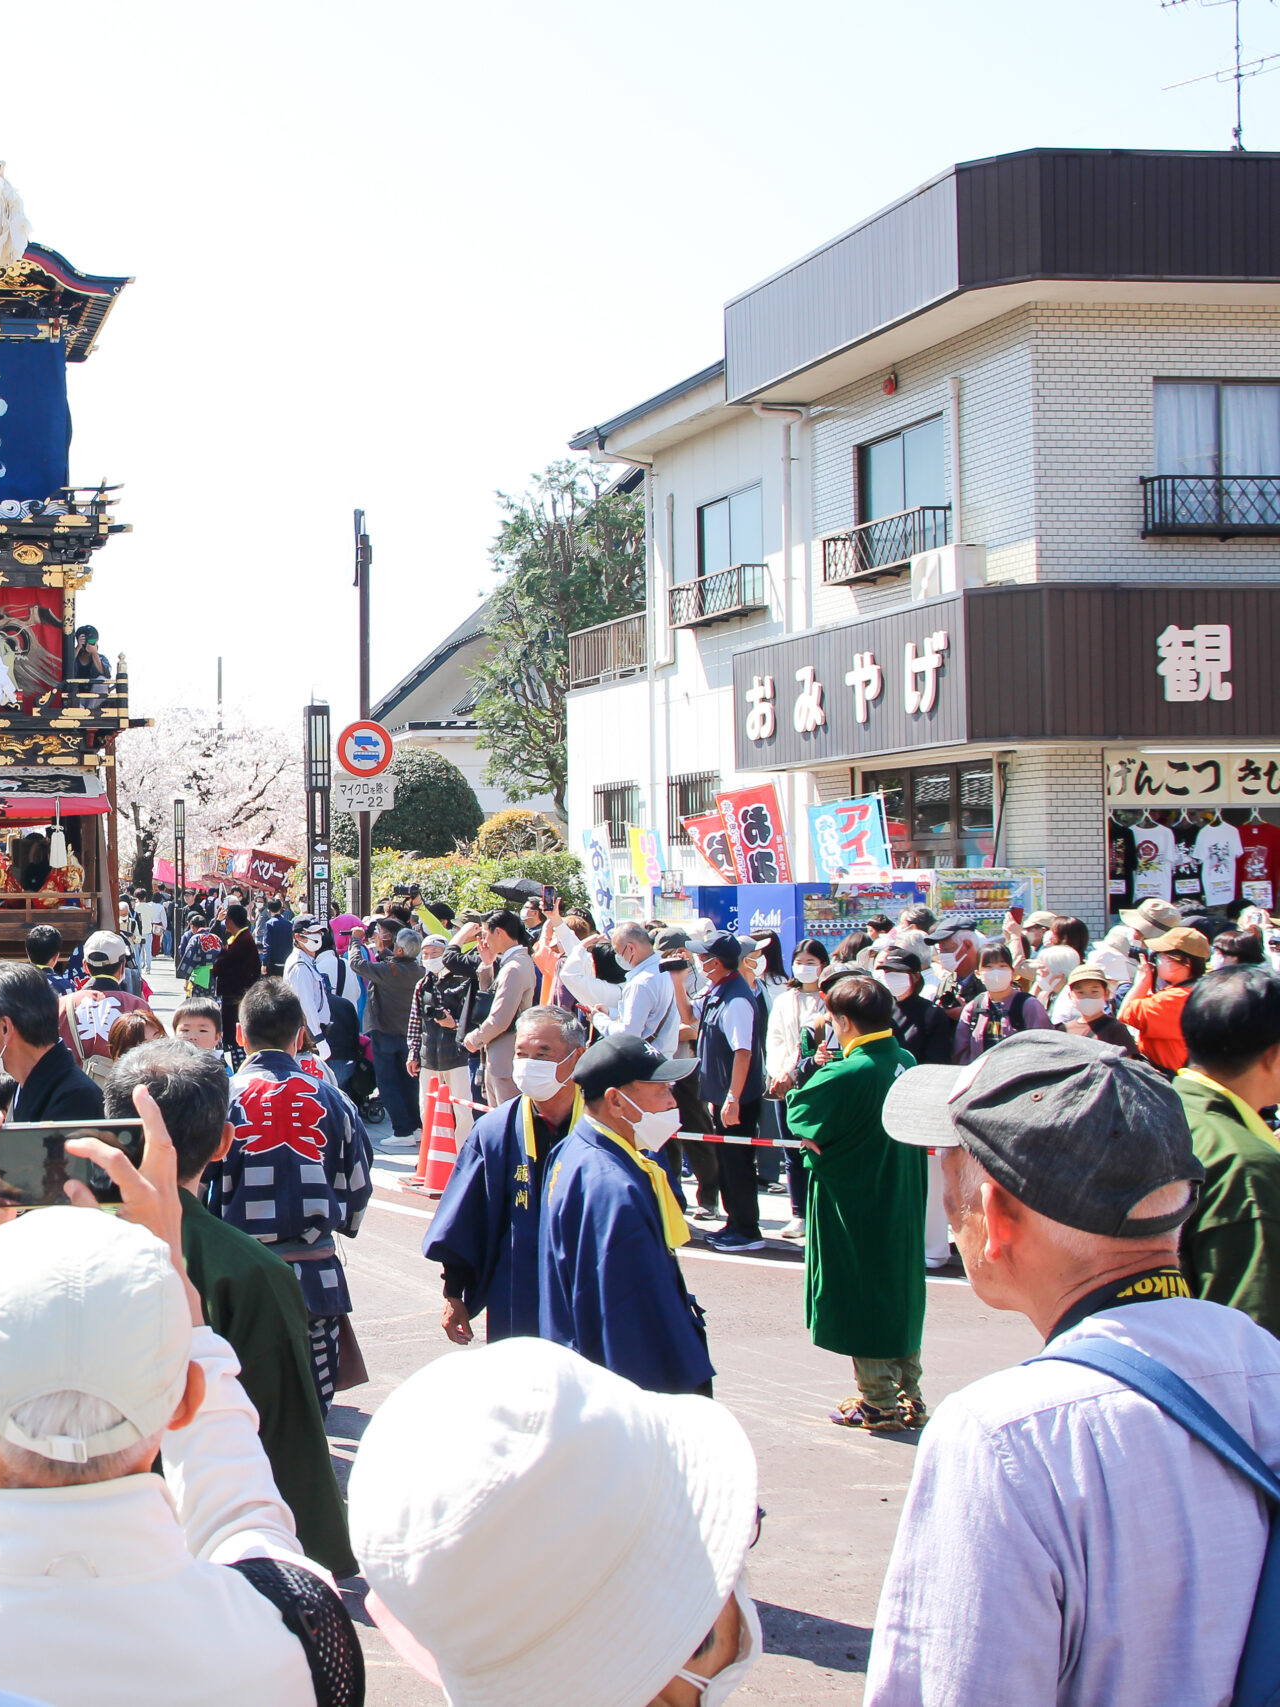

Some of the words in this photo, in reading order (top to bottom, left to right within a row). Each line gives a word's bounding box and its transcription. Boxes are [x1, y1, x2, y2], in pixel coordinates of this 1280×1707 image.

[744, 630, 949, 742] おみやげ
[1156, 624, 1233, 702] 観
[339, 782, 389, 796] マイクロを除く
[1106, 757, 1222, 796] げんこつ
[835, 804, 874, 866] アイ
[749, 908, 782, 927] Asahi
